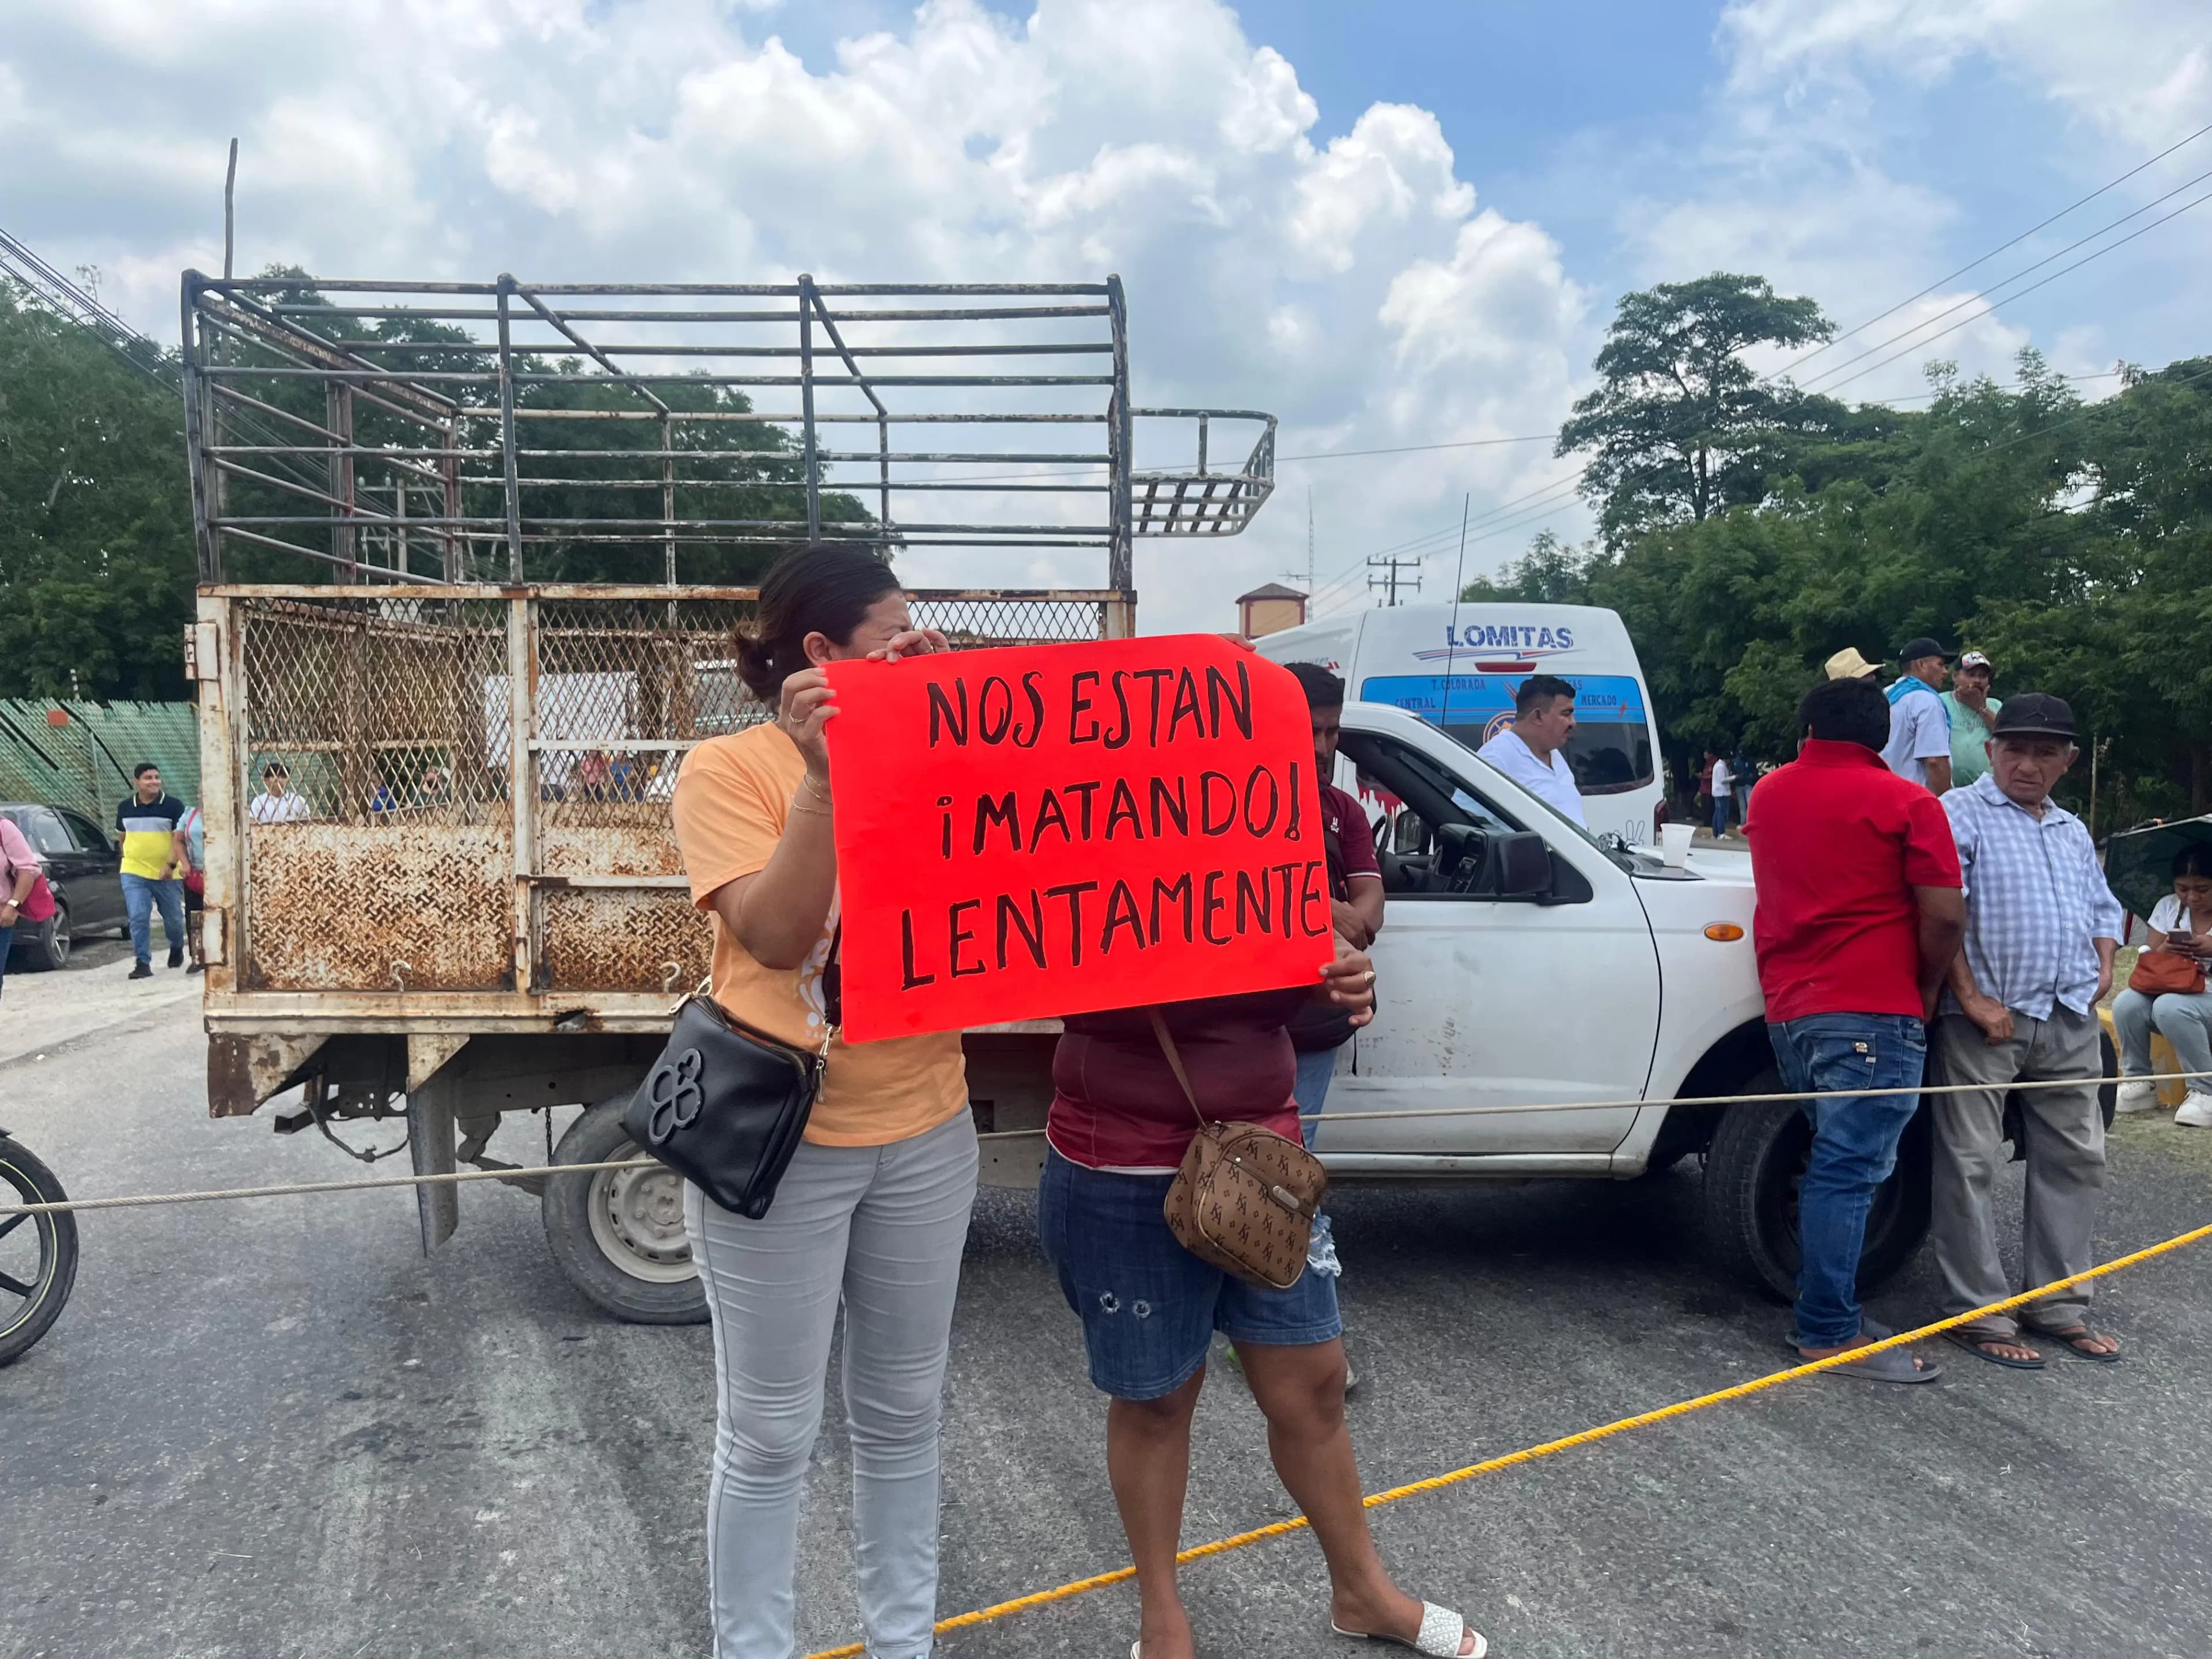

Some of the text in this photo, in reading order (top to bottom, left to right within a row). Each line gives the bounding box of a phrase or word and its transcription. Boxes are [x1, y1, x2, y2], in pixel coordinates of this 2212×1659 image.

[1446, 625, 1574, 649] LOMITAS
[1441, 678, 1486, 691] COLORADA
[926, 661, 1252, 749] NOS ESTAN
[1395, 697, 1435, 709] CENTRAL
[1581, 694, 1617, 706] MERCADO
[902, 861, 1328, 991] LENTAMENTE
